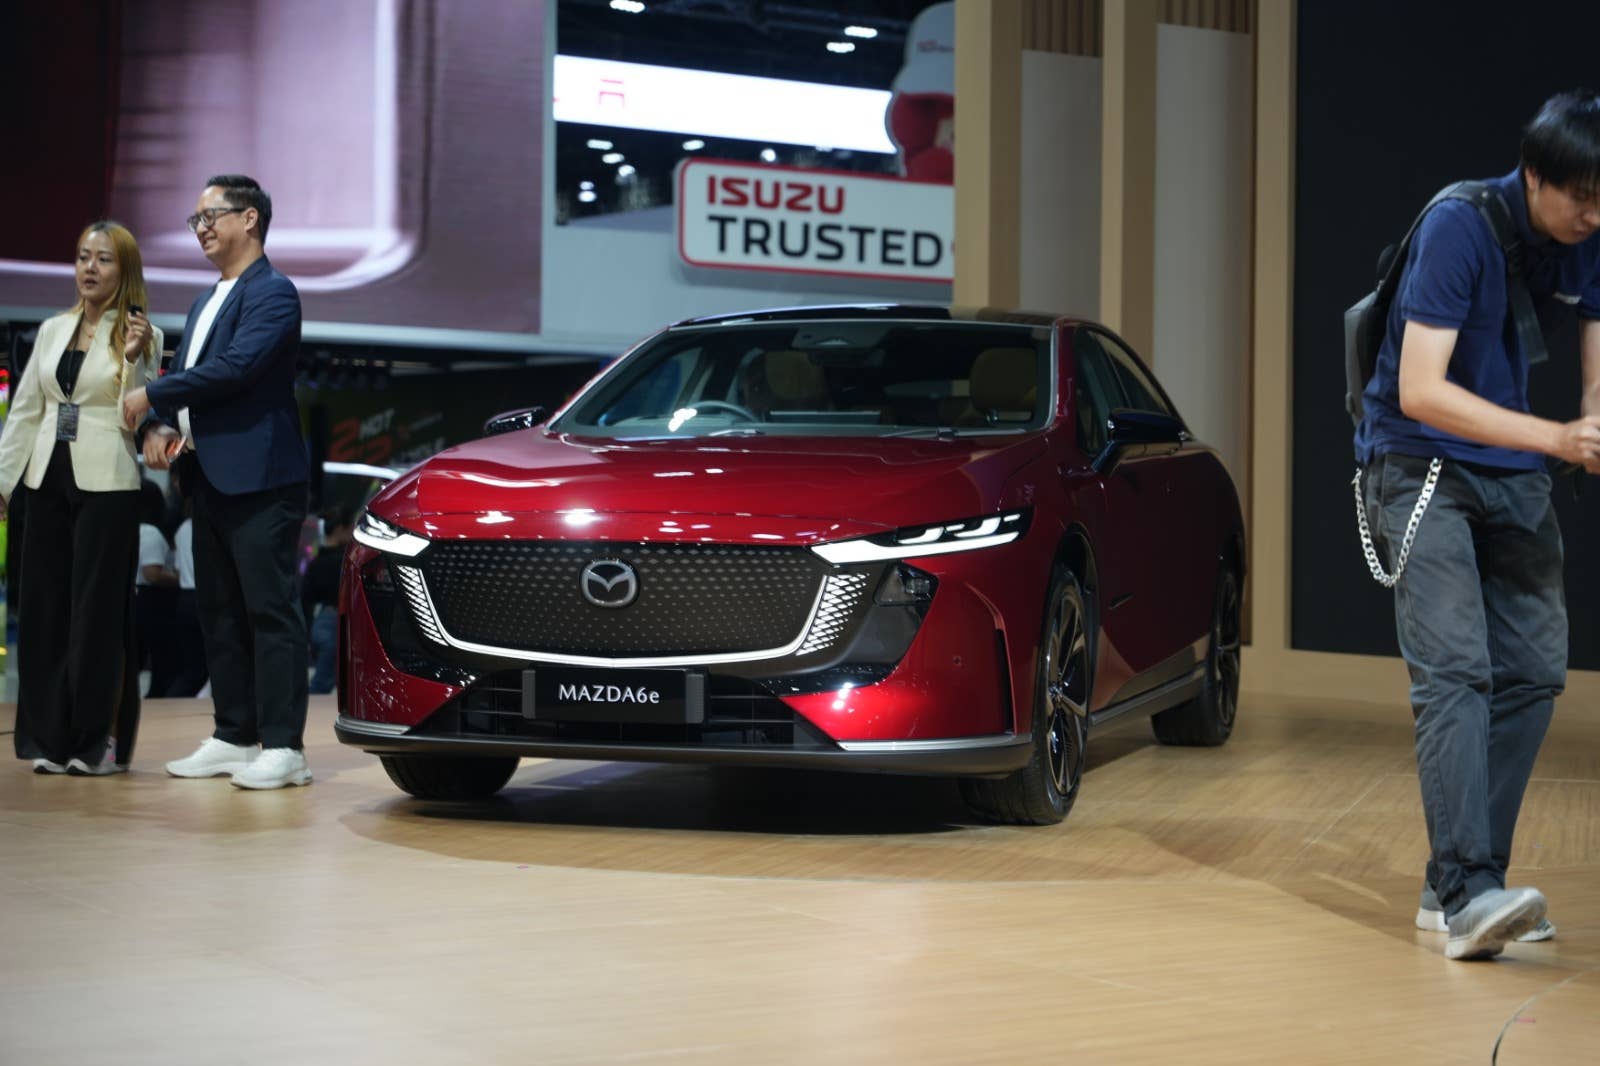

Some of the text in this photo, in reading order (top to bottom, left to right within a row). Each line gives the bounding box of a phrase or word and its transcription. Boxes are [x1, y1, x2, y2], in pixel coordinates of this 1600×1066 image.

[708, 175, 845, 214] ISUZU
[708, 215, 944, 269] TRUSTED
[558, 683, 660, 704] MAZDA6e
